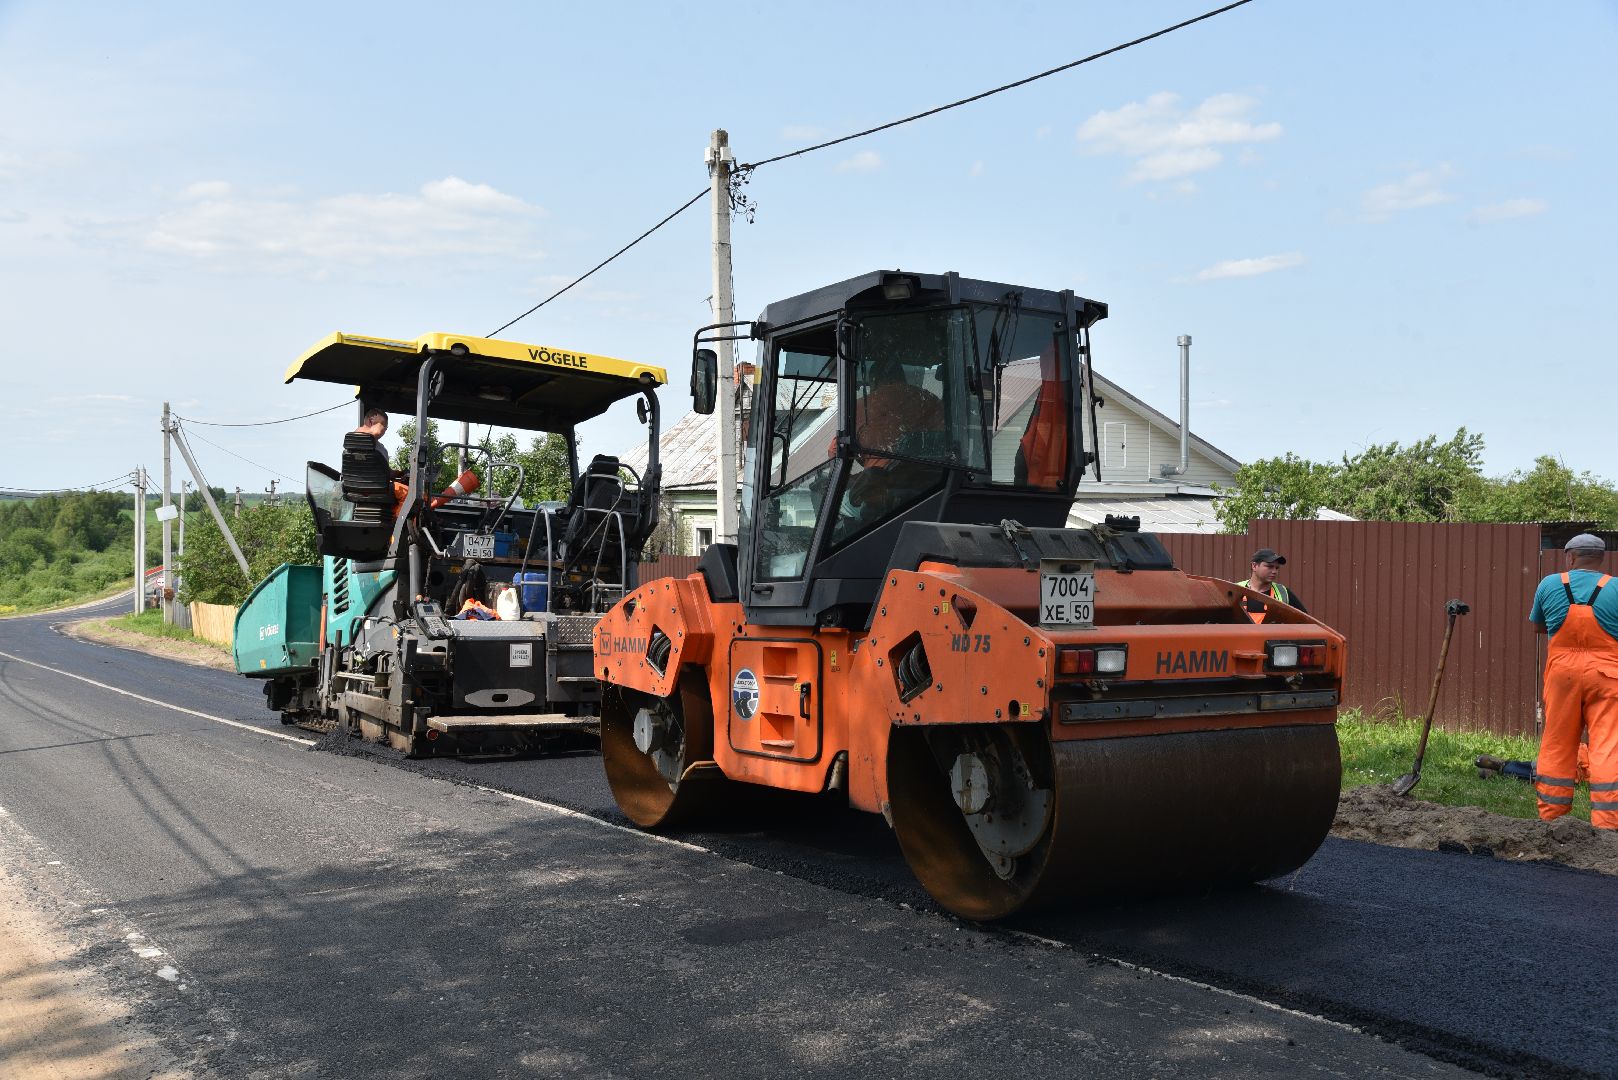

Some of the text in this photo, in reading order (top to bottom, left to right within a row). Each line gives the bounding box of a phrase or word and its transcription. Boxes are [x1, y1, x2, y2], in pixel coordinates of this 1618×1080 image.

[528, 347, 587, 368] VÖGELE
[468, 536, 491, 547] 0477
[482, 549, 492, 558] 50
[1049, 577, 1088, 597] 7004
[1075, 605, 1090, 620] 50
[614, 637, 647, 653] HAMM
[952, 634, 991, 653] HD 75
[1156, 650, 1228, 674] HAMM
